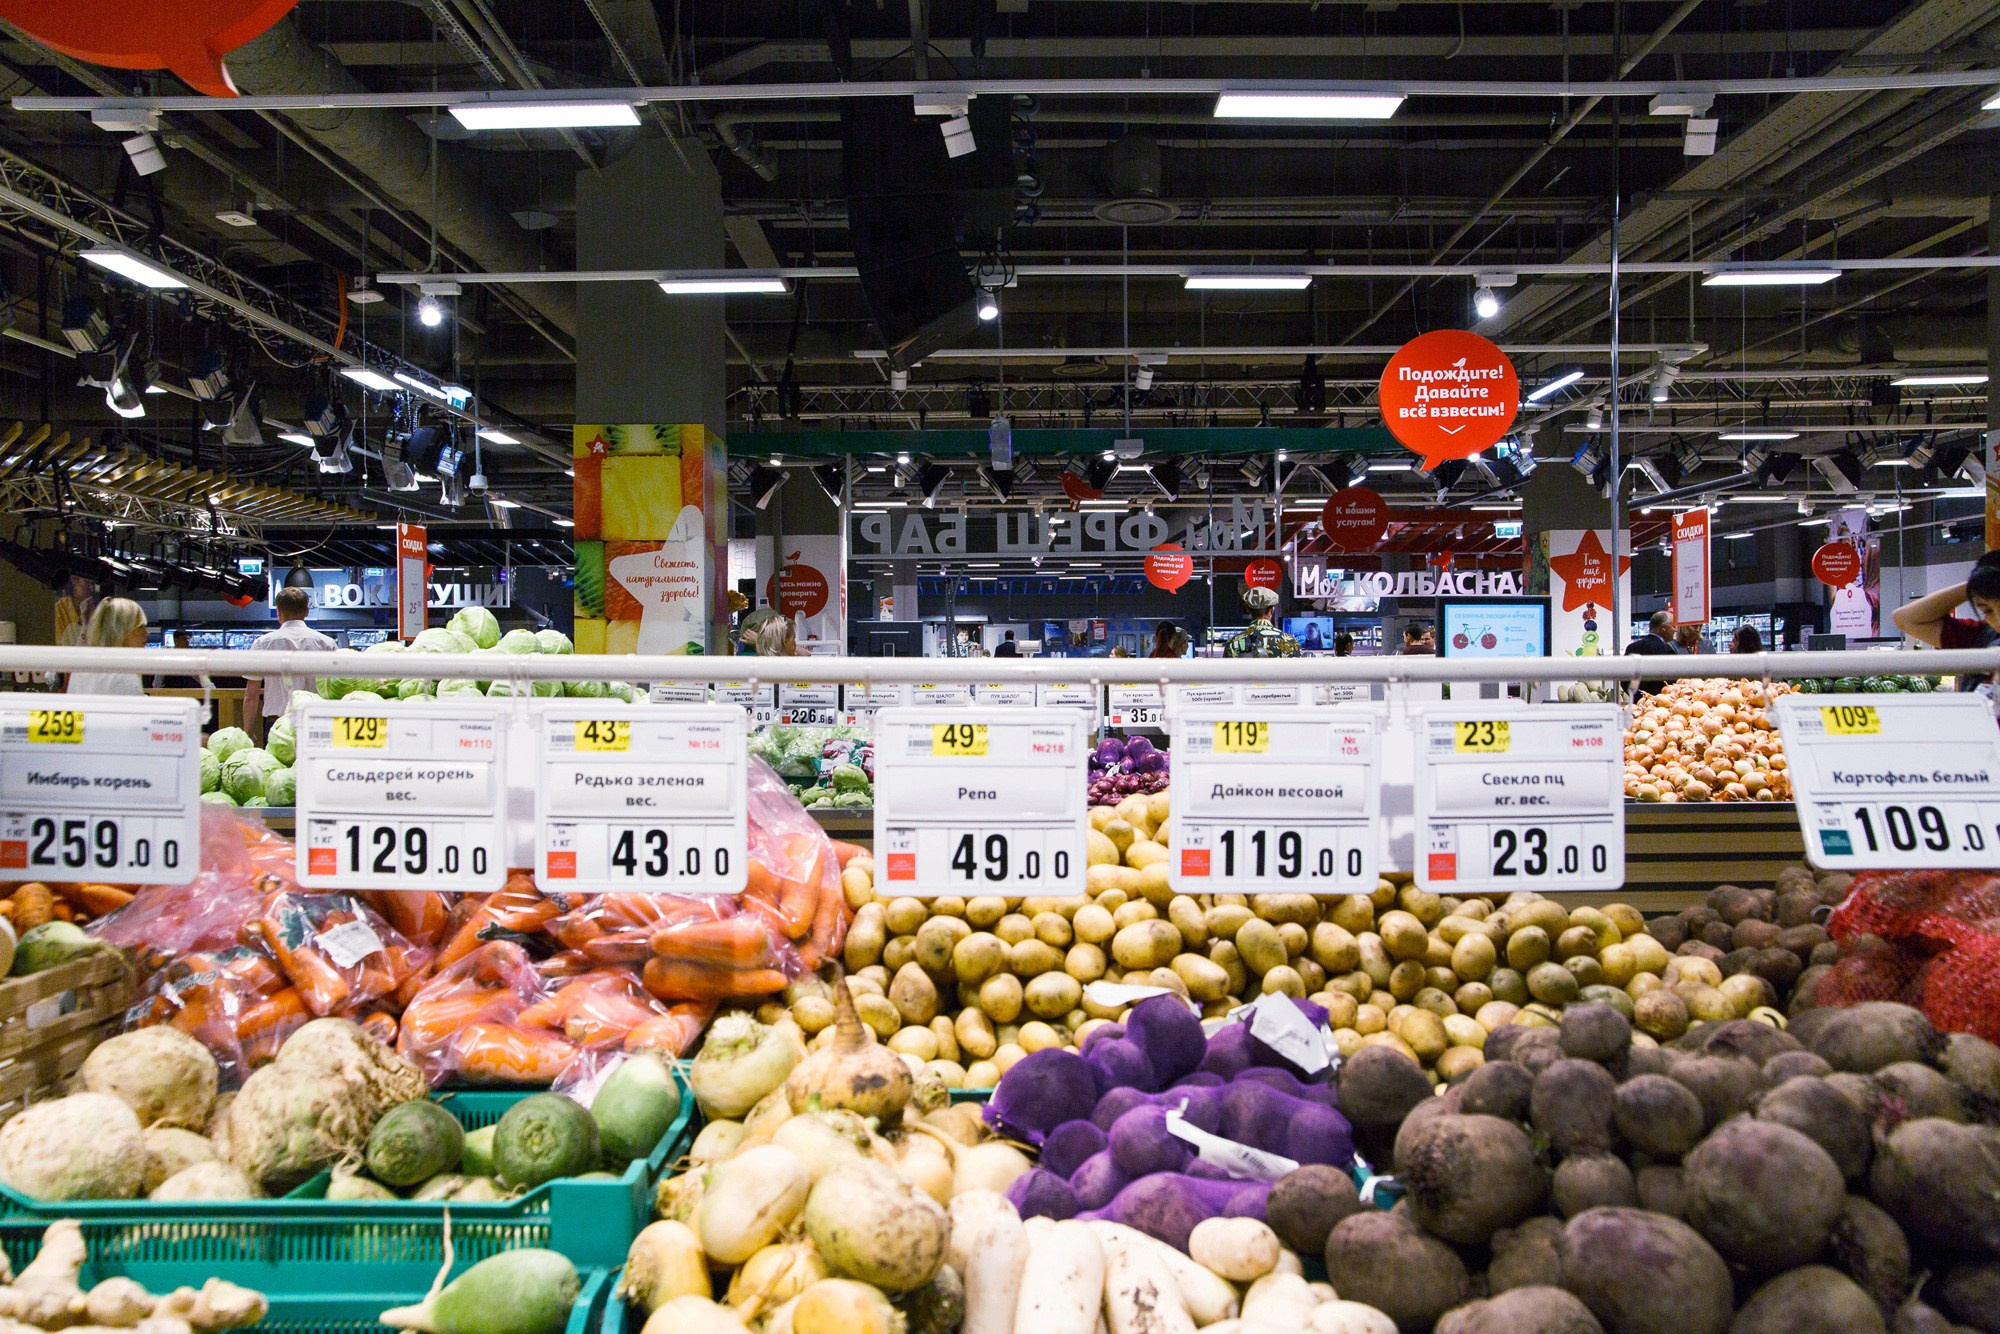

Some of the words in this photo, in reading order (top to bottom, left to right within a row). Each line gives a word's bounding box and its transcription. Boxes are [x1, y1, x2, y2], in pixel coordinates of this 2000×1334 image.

[1399, 365, 1503, 383] Подождите!
[1414, 384, 1489, 402] Давайте
[1399, 404, 1427, 418] всё
[1430, 402, 1504, 417] взвесим!
[1336, 506, 1343, 514] К
[1345, 506, 1376, 514] вашим
[1336, 518, 1376, 528] услугам!
[1677, 524, 1704, 540] СКИДКИ
[402, 538, 424, 552] СКИДКА
[654, 555, 699, 570] Свежесть,
[1583, 553, 1600, 565] Тот
[1301, 565, 1341, 596] Моя
[1576, 572, 1606, 589] фрукт!
[1583, 567, 1600, 577] ещё
[626, 574, 699, 588] натуральность,
[325, 584, 384, 606] ВОК
[660, 585, 700, 602] здоровье!
[37, 710, 75, 737] 259
[1829, 706, 1869, 728] 109
[342, 717, 378, 741] 129
[583, 721, 616, 744] 43
[941, 724, 975, 749] 49
[1222, 721, 1258, 746] 119
[1463, 721, 1496, 747] 23
[459, 738, 492, 750] №110
[27, 771, 90, 789] Имбирь
[94, 777, 152, 790] корень
[326, 767, 413, 784] Сельдерей
[417, 769, 474, 783] корень
[575, 773, 633, 788] Редька
[637, 775, 705, 787] зеленая
[1482, 773, 1540, 786] Свекла
[1544, 775, 1565, 786] пц
[1833, 770, 1928, 787] Картофель
[1932, 770, 1990, 784] белый
[386, 791, 417, 801] вес.
[958, 787, 997, 800] Репа
[1211, 783, 1274, 800] Дайкон
[1278, 785, 1343, 798] весовой
[625, 796, 657, 807] вес.
[1495, 796, 1515, 806] кг.
[1519, 795, 1550, 806] вес.
[1854, 805, 2000, 852] 109.0
[346, 825, 487, 874] 129.00
[612, 829, 729, 877] 43.00
[952, 833, 1069, 881] 49.00
[1220, 830, 1362, 879] 119.00
[1493, 828, 1607, 876] 23.00
